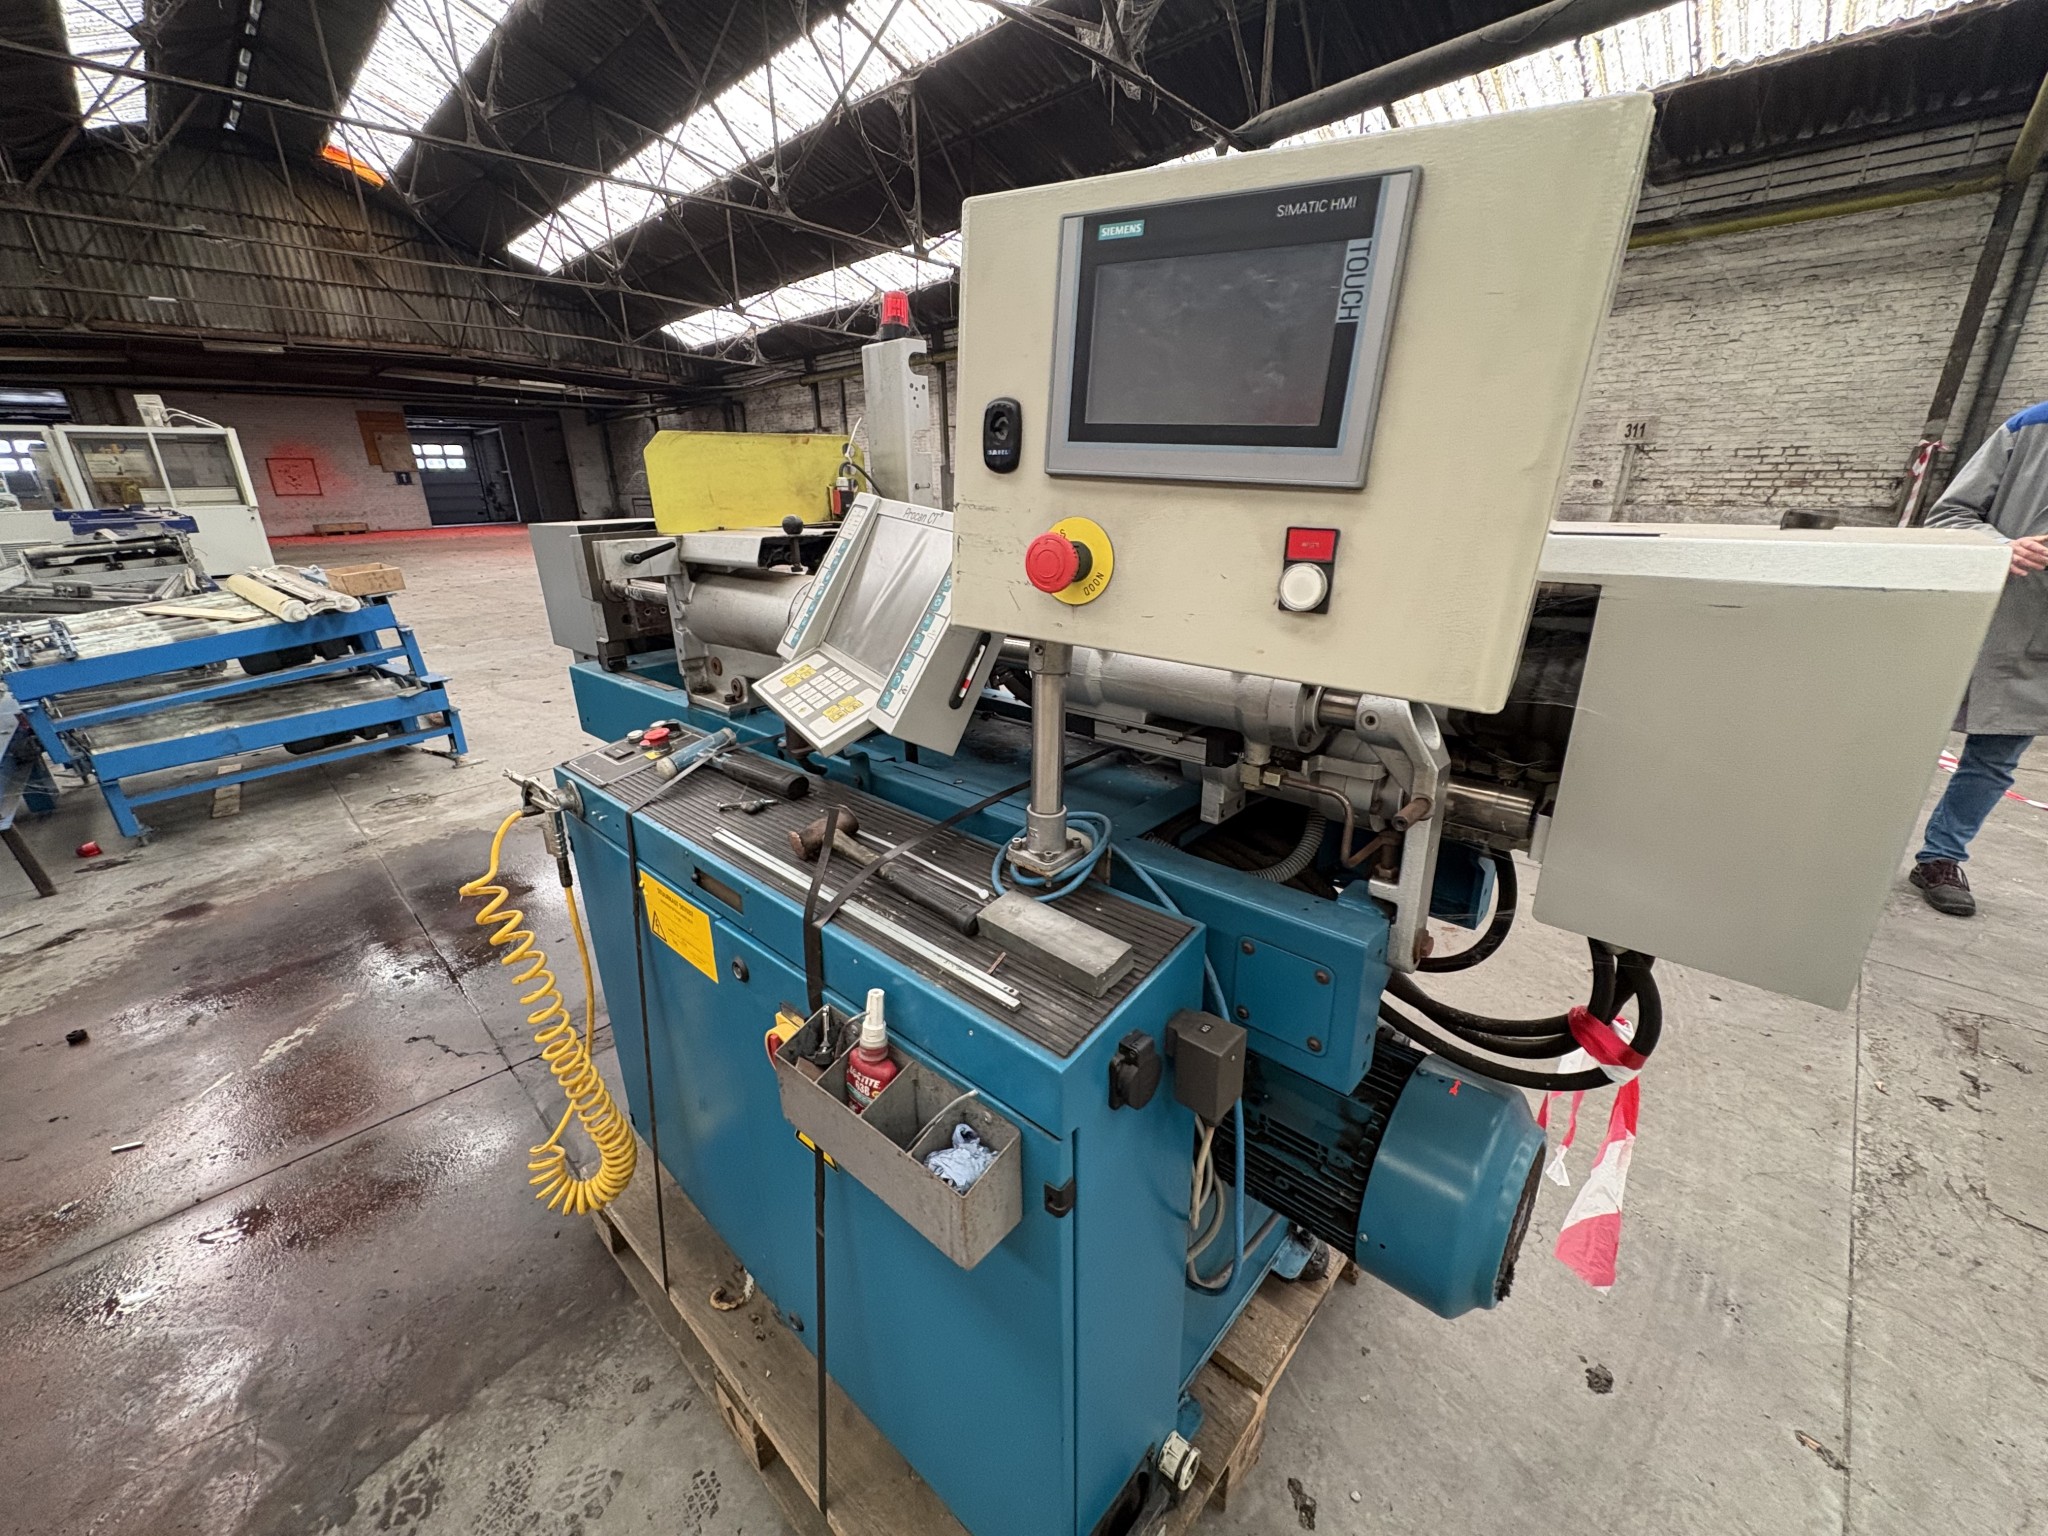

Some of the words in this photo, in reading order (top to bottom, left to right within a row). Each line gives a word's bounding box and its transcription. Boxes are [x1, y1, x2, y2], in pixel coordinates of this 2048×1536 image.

[1276, 199, 1328, 218] SIMATIC
[1331, 196, 1358, 211] HMI
[1101, 223, 1142, 237] SIEMENS
[1338, 241, 1372, 321] TOUCH
[1624, 423, 1647, 438] 311
[1083, 572, 1104, 596] NOOD
